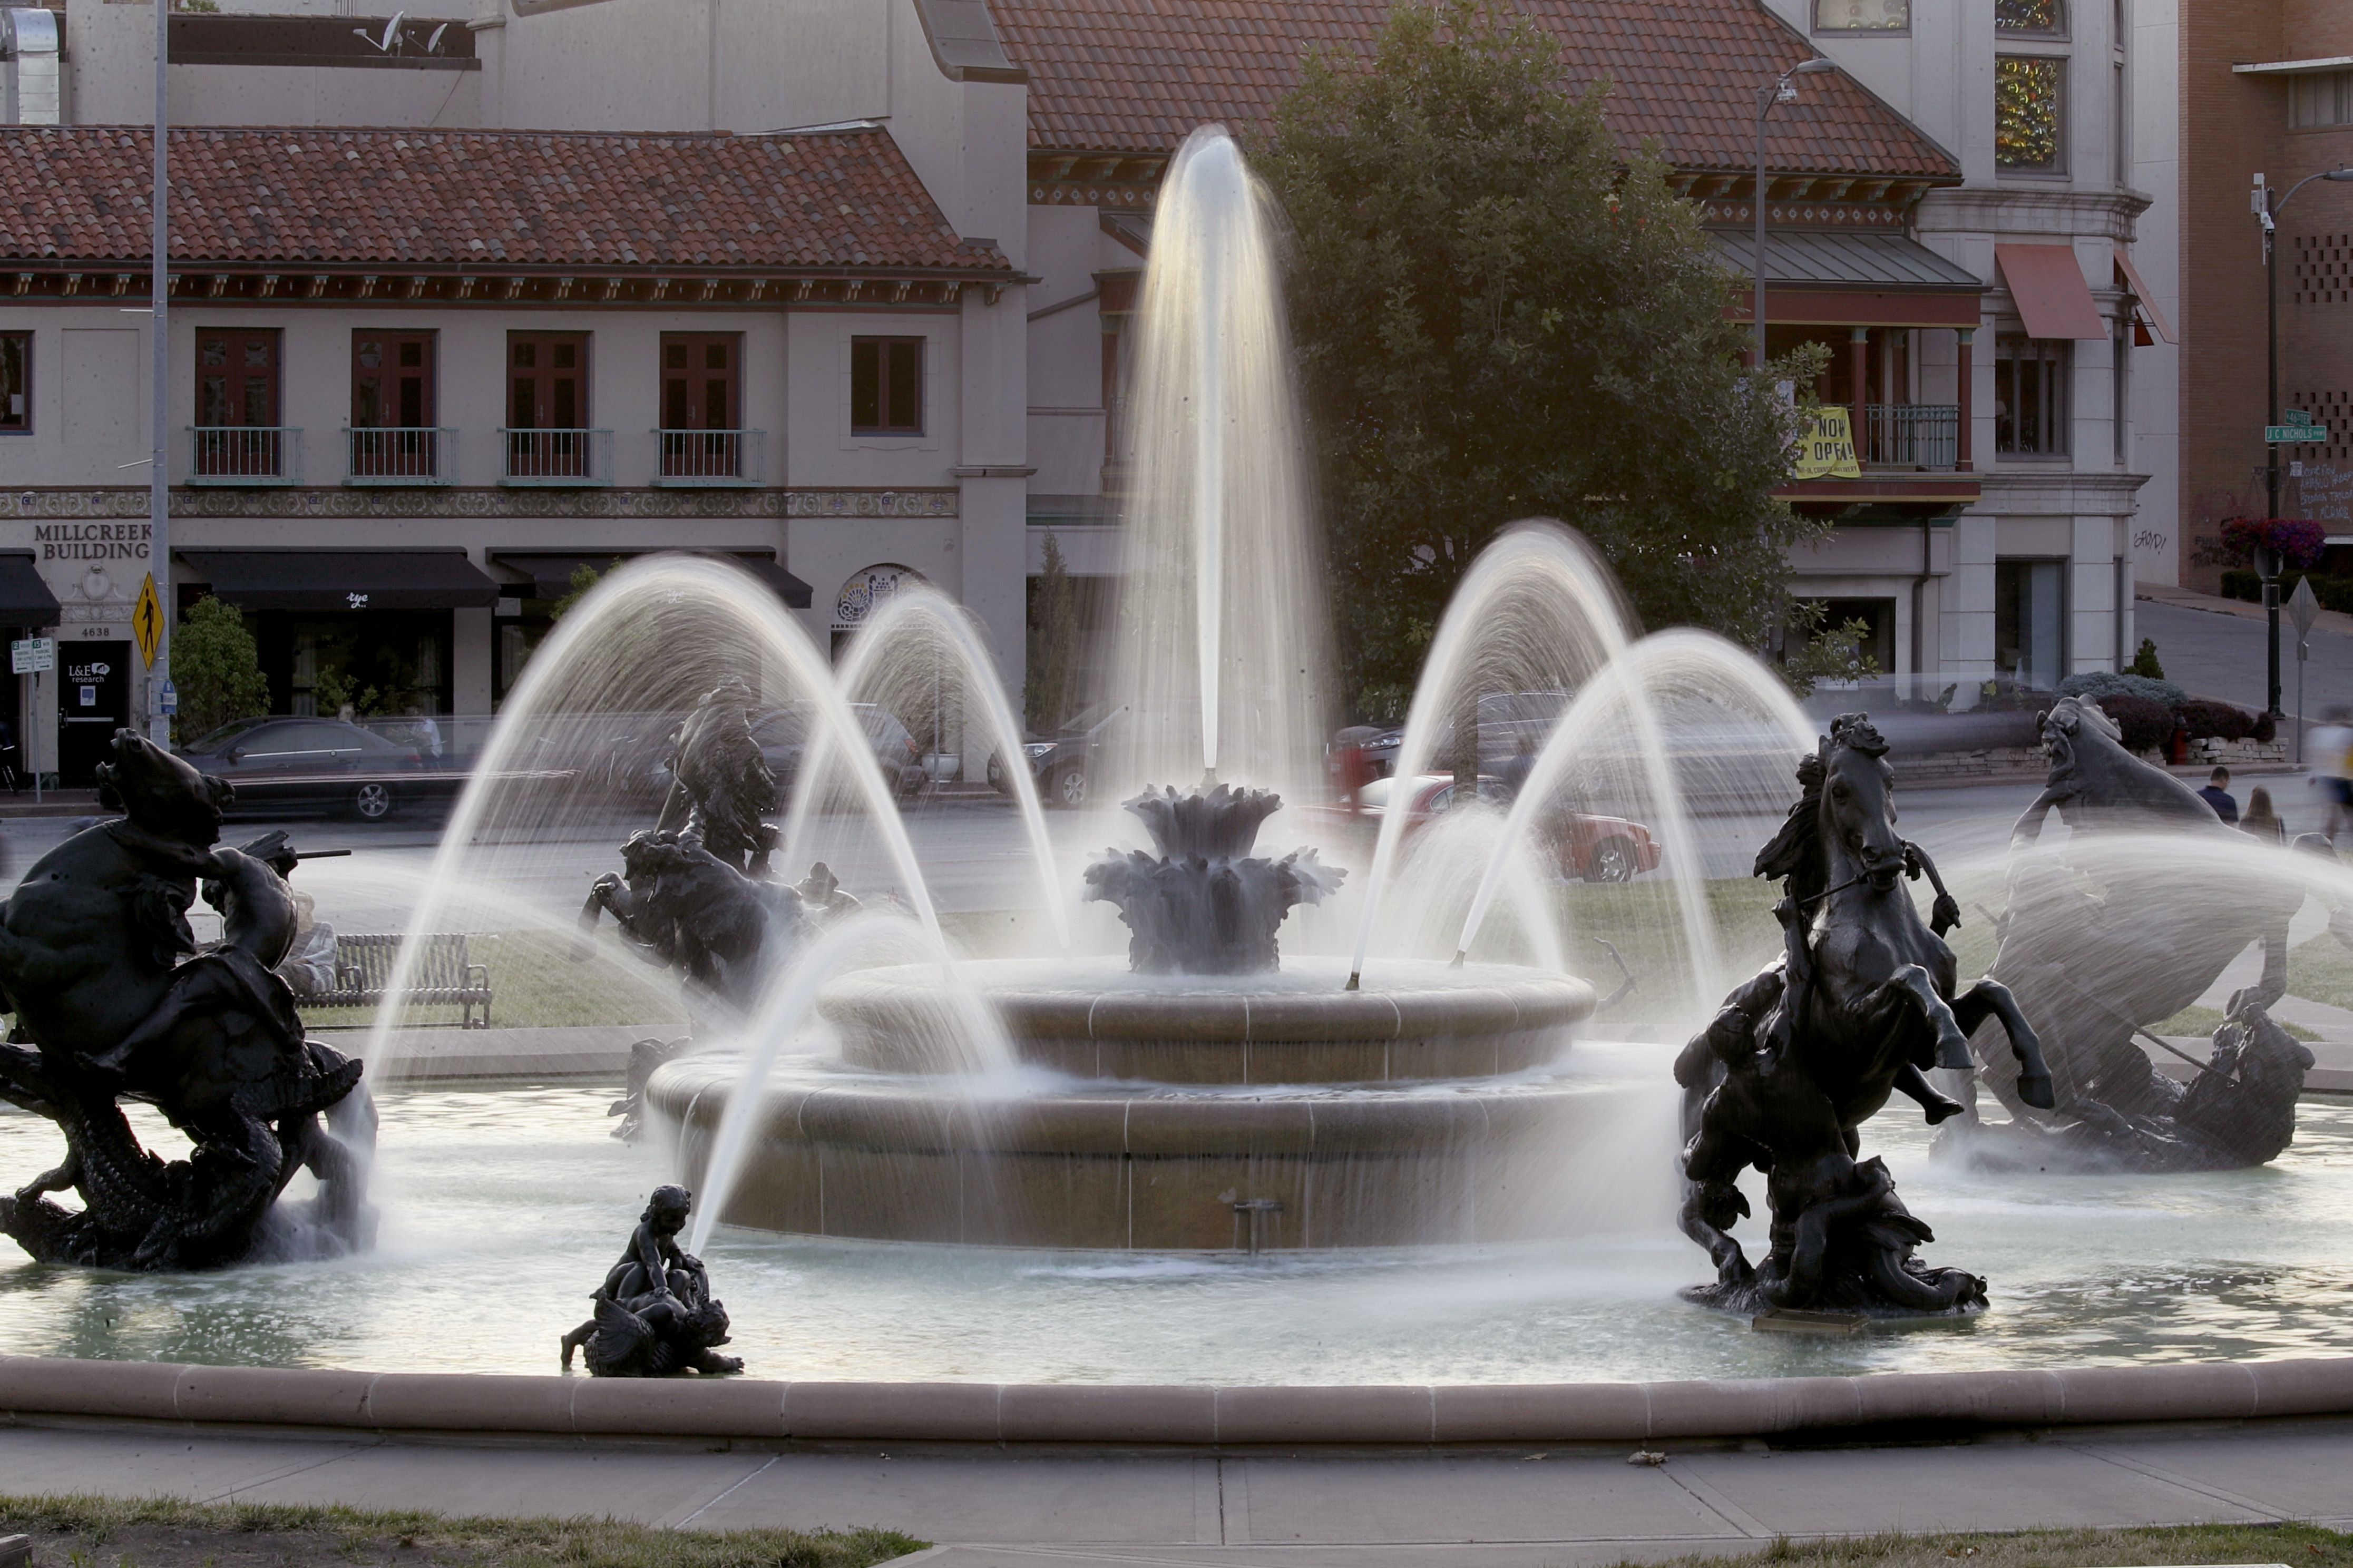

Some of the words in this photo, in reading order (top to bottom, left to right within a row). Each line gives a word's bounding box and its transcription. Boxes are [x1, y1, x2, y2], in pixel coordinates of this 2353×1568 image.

[1819, 418, 1846, 437] NOW
[2268, 429, 2272, 439] J
[2275, 429, 2280, 439] C
[2282, 428, 2312, 439] NICHOLS
[35, 524, 152, 541] MILLCREEK
[43, 543, 150, 560] BUILDING
[346, 592, 368, 609] rye
[82, 628, 110, 637] 4638
[69, 665, 91, 677] L&E
